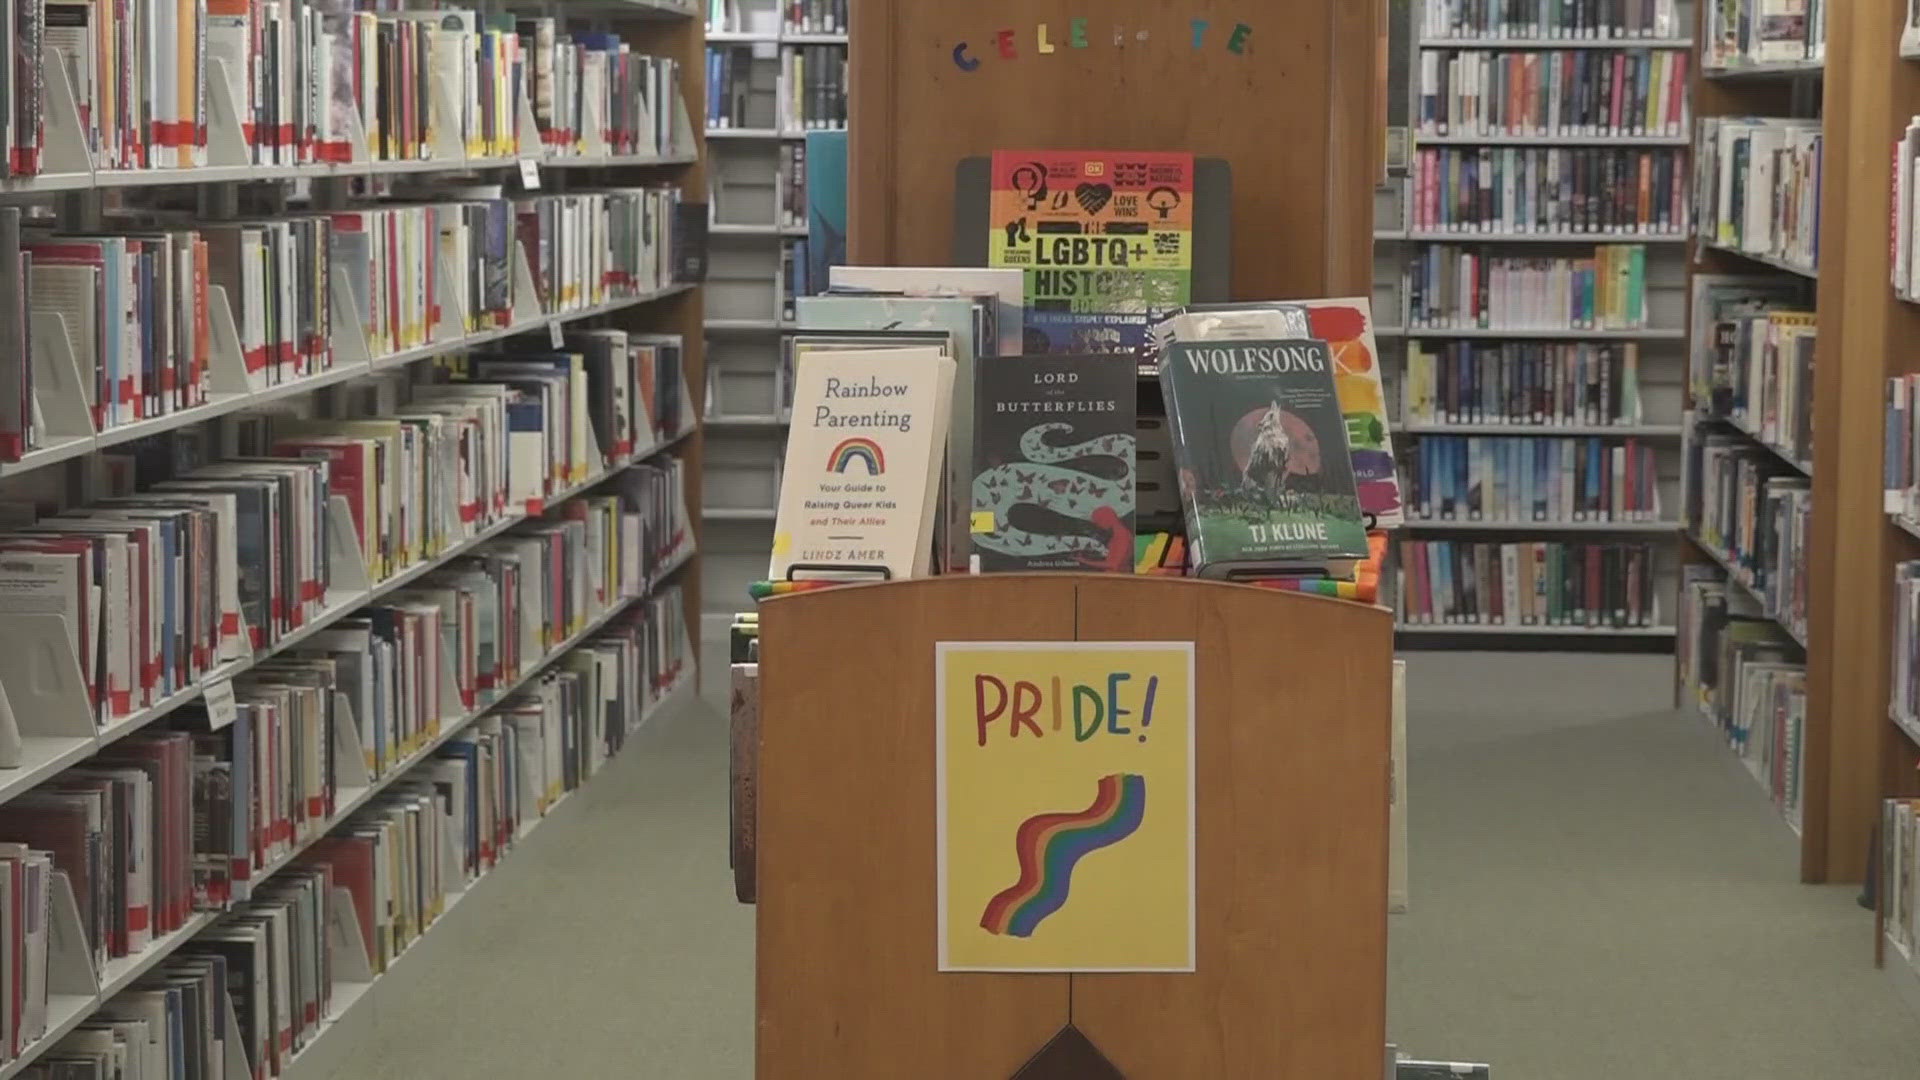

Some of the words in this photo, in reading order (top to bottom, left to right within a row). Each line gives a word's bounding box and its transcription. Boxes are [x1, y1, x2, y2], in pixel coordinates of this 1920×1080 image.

[1114, 195, 1138, 206] LOVE
[1114, 207, 1138, 217] WINS
[1036, 237, 1148, 267] LGBTQ+
[1186, 346, 1325, 375] WOLFSONG
[1034, 373, 1079, 384] LORD
[825, 376, 908, 398] Rainbow
[996, 400, 1115, 412] BUTTERFLIES
[814, 406, 912, 432] Parenting
[820, 483, 841, 493] Your
[844, 483, 873, 492] Guide
[876, 484, 886, 492] to
[804, 501, 840, 510] Raising
[843, 501, 872, 509] Queer
[875, 501, 896, 509] Kids
[832, 517, 856, 525] Their
[859, 517, 886, 525] Allies
[1248, 524, 1266, 542] TJ
[1272, 522, 1328, 541] KLUNE
[802, 550, 842, 560] LINDZ
[848, 550, 884, 560] AMER
[974, 672, 1158, 747] PRIDE!
